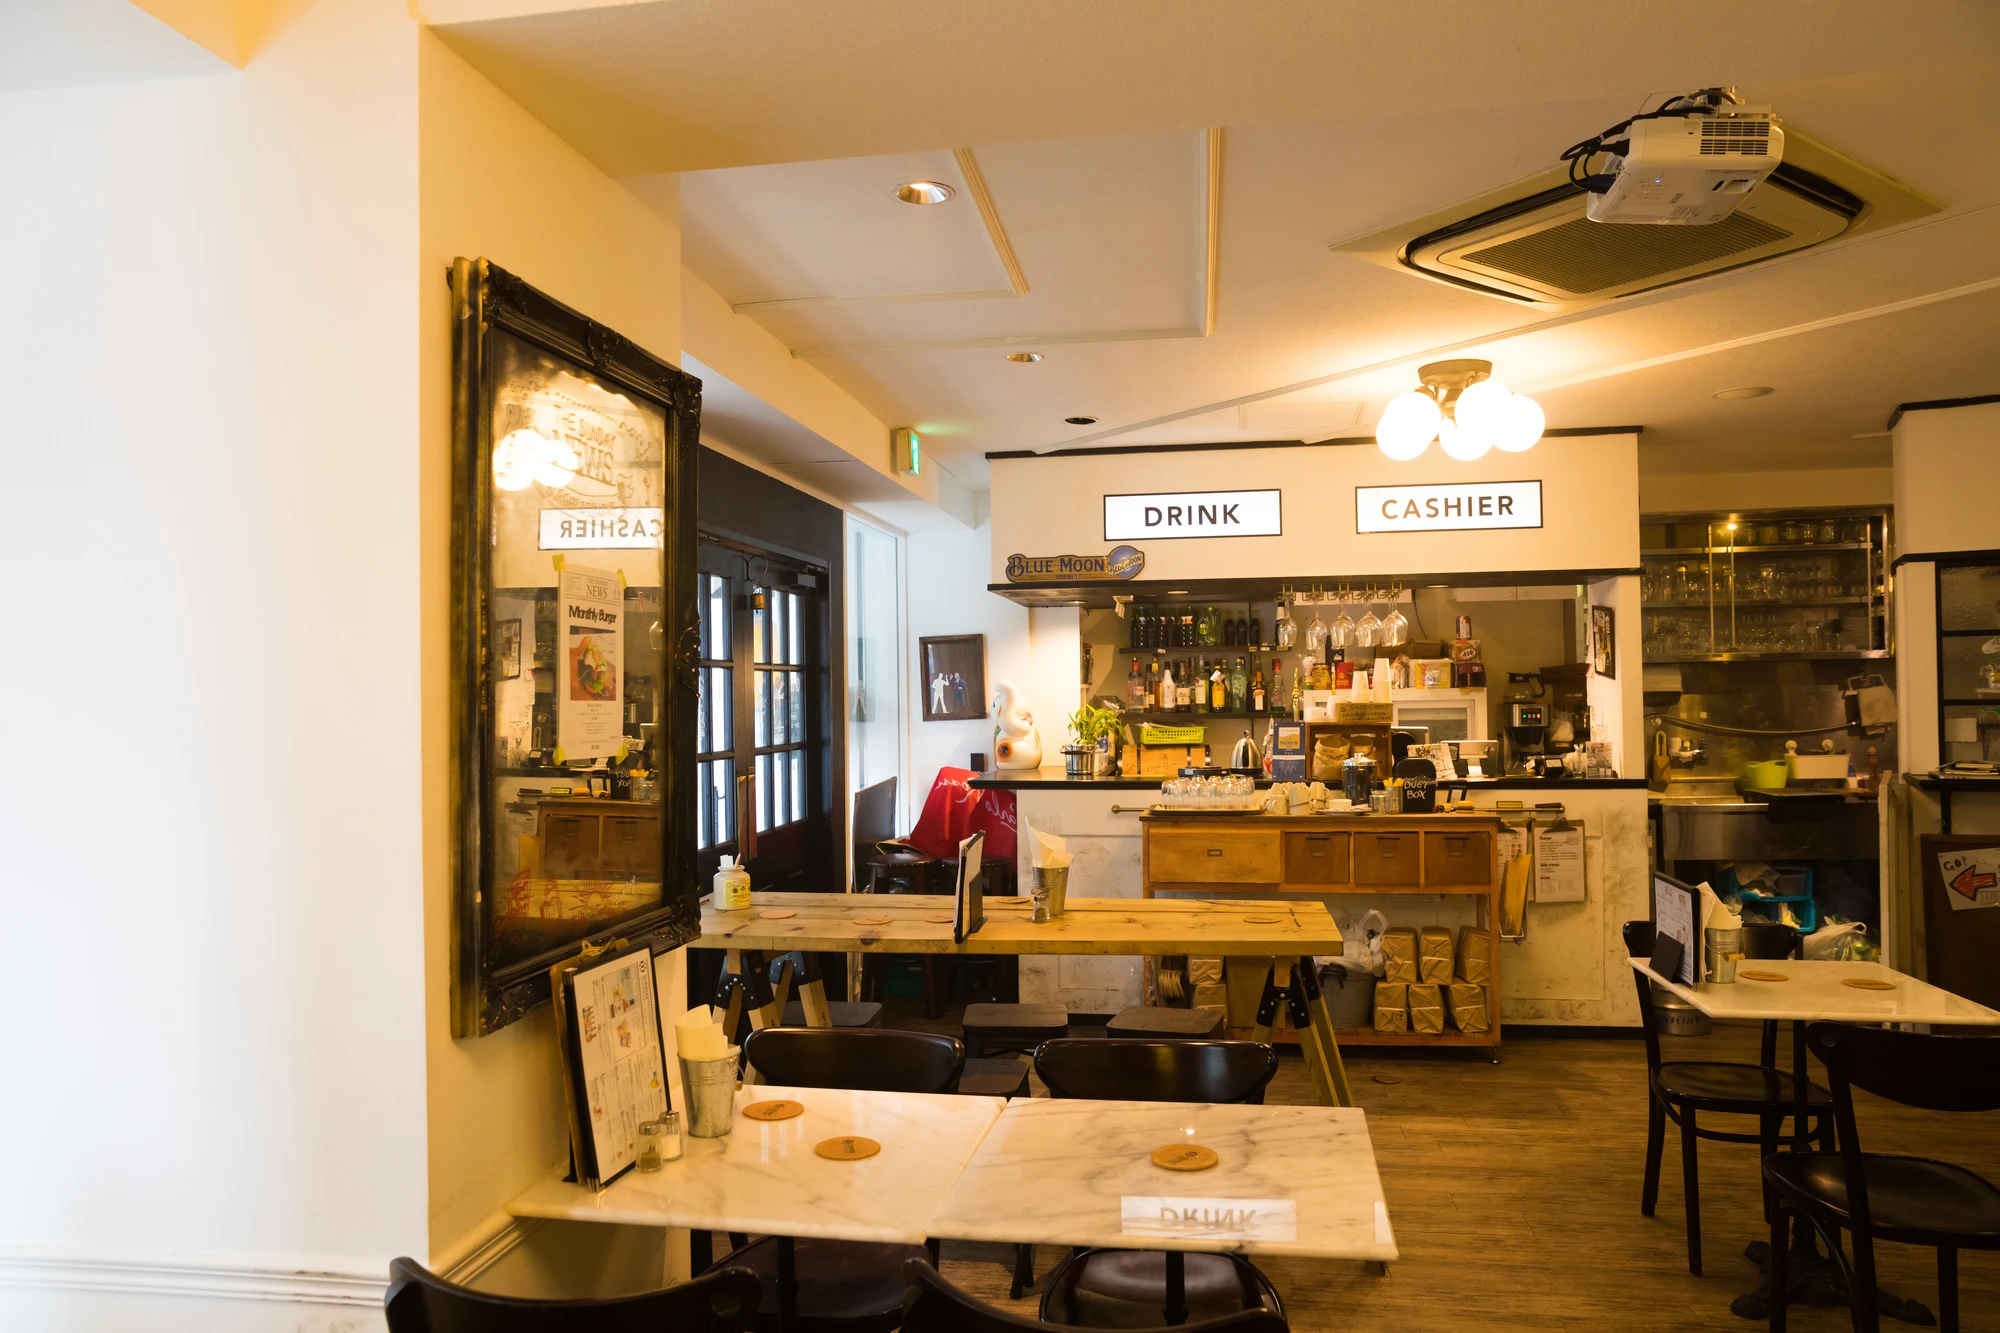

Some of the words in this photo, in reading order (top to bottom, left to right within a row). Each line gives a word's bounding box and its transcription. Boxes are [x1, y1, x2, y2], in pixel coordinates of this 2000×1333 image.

[1144, 503, 1241, 527] DRINK
[1381, 494, 1514, 520] CASHIER
[1008, 556, 1054, 578] BLUE
[1060, 557, 1105, 573] MOON
[586, 584, 608, 599] NEWS
[568, 604, 598, 623] Monthly
[1404, 780, 1429, 790] DUST
[1406, 790, 1426, 799] BOX
